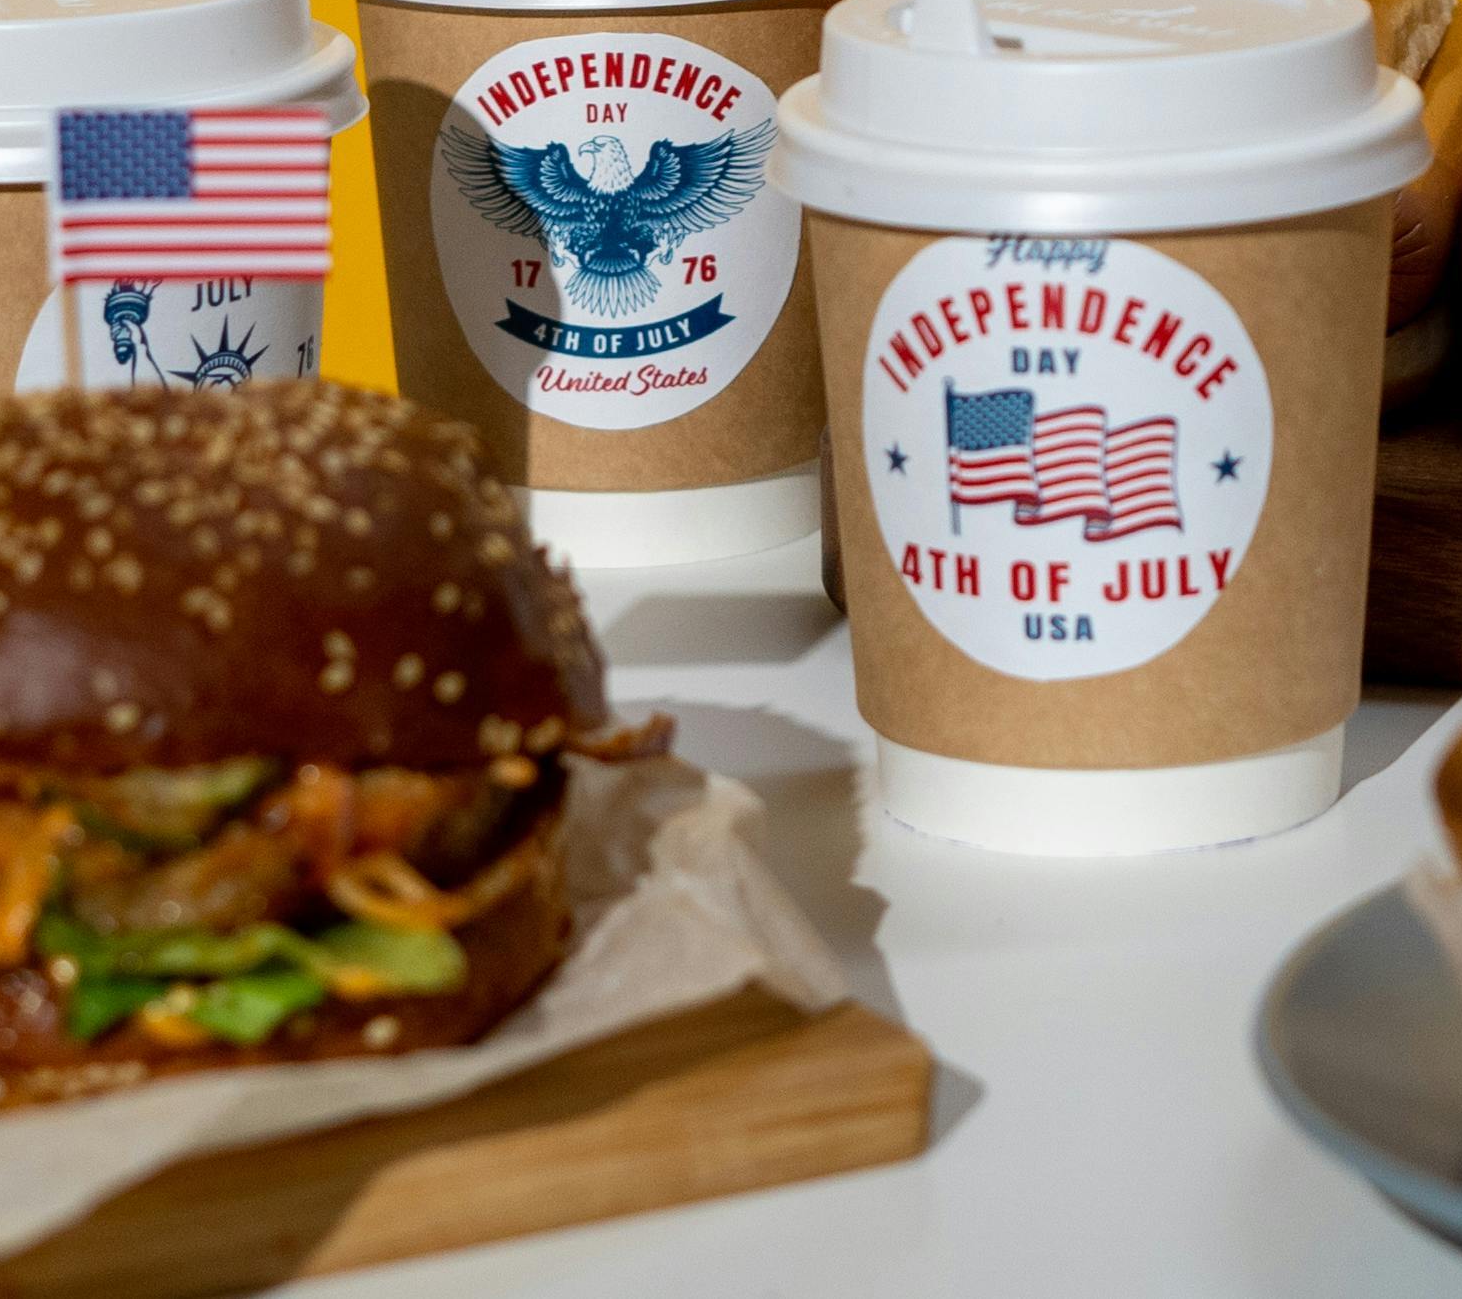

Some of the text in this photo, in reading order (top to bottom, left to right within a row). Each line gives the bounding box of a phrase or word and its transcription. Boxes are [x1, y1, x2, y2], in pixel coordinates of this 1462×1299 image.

[477, 52, 743, 126] INDEPENDENCE
[586, 103, 628, 123] DAY
[985, 231, 1111, 275] Happy
[511, 255, 717, 288] 17 76
[191, 275, 254, 312] JULY
[533, 317, 693, 353] 4TH OF JULY
[879, 282, 1240, 400] INDEPENDENCE
[1011, 347, 1080, 375] DAY
[537, 364, 708, 396] United States
[900, 543, 1233, 602] 4TH OF JULY
[1025, 614, 1094, 641] USA
